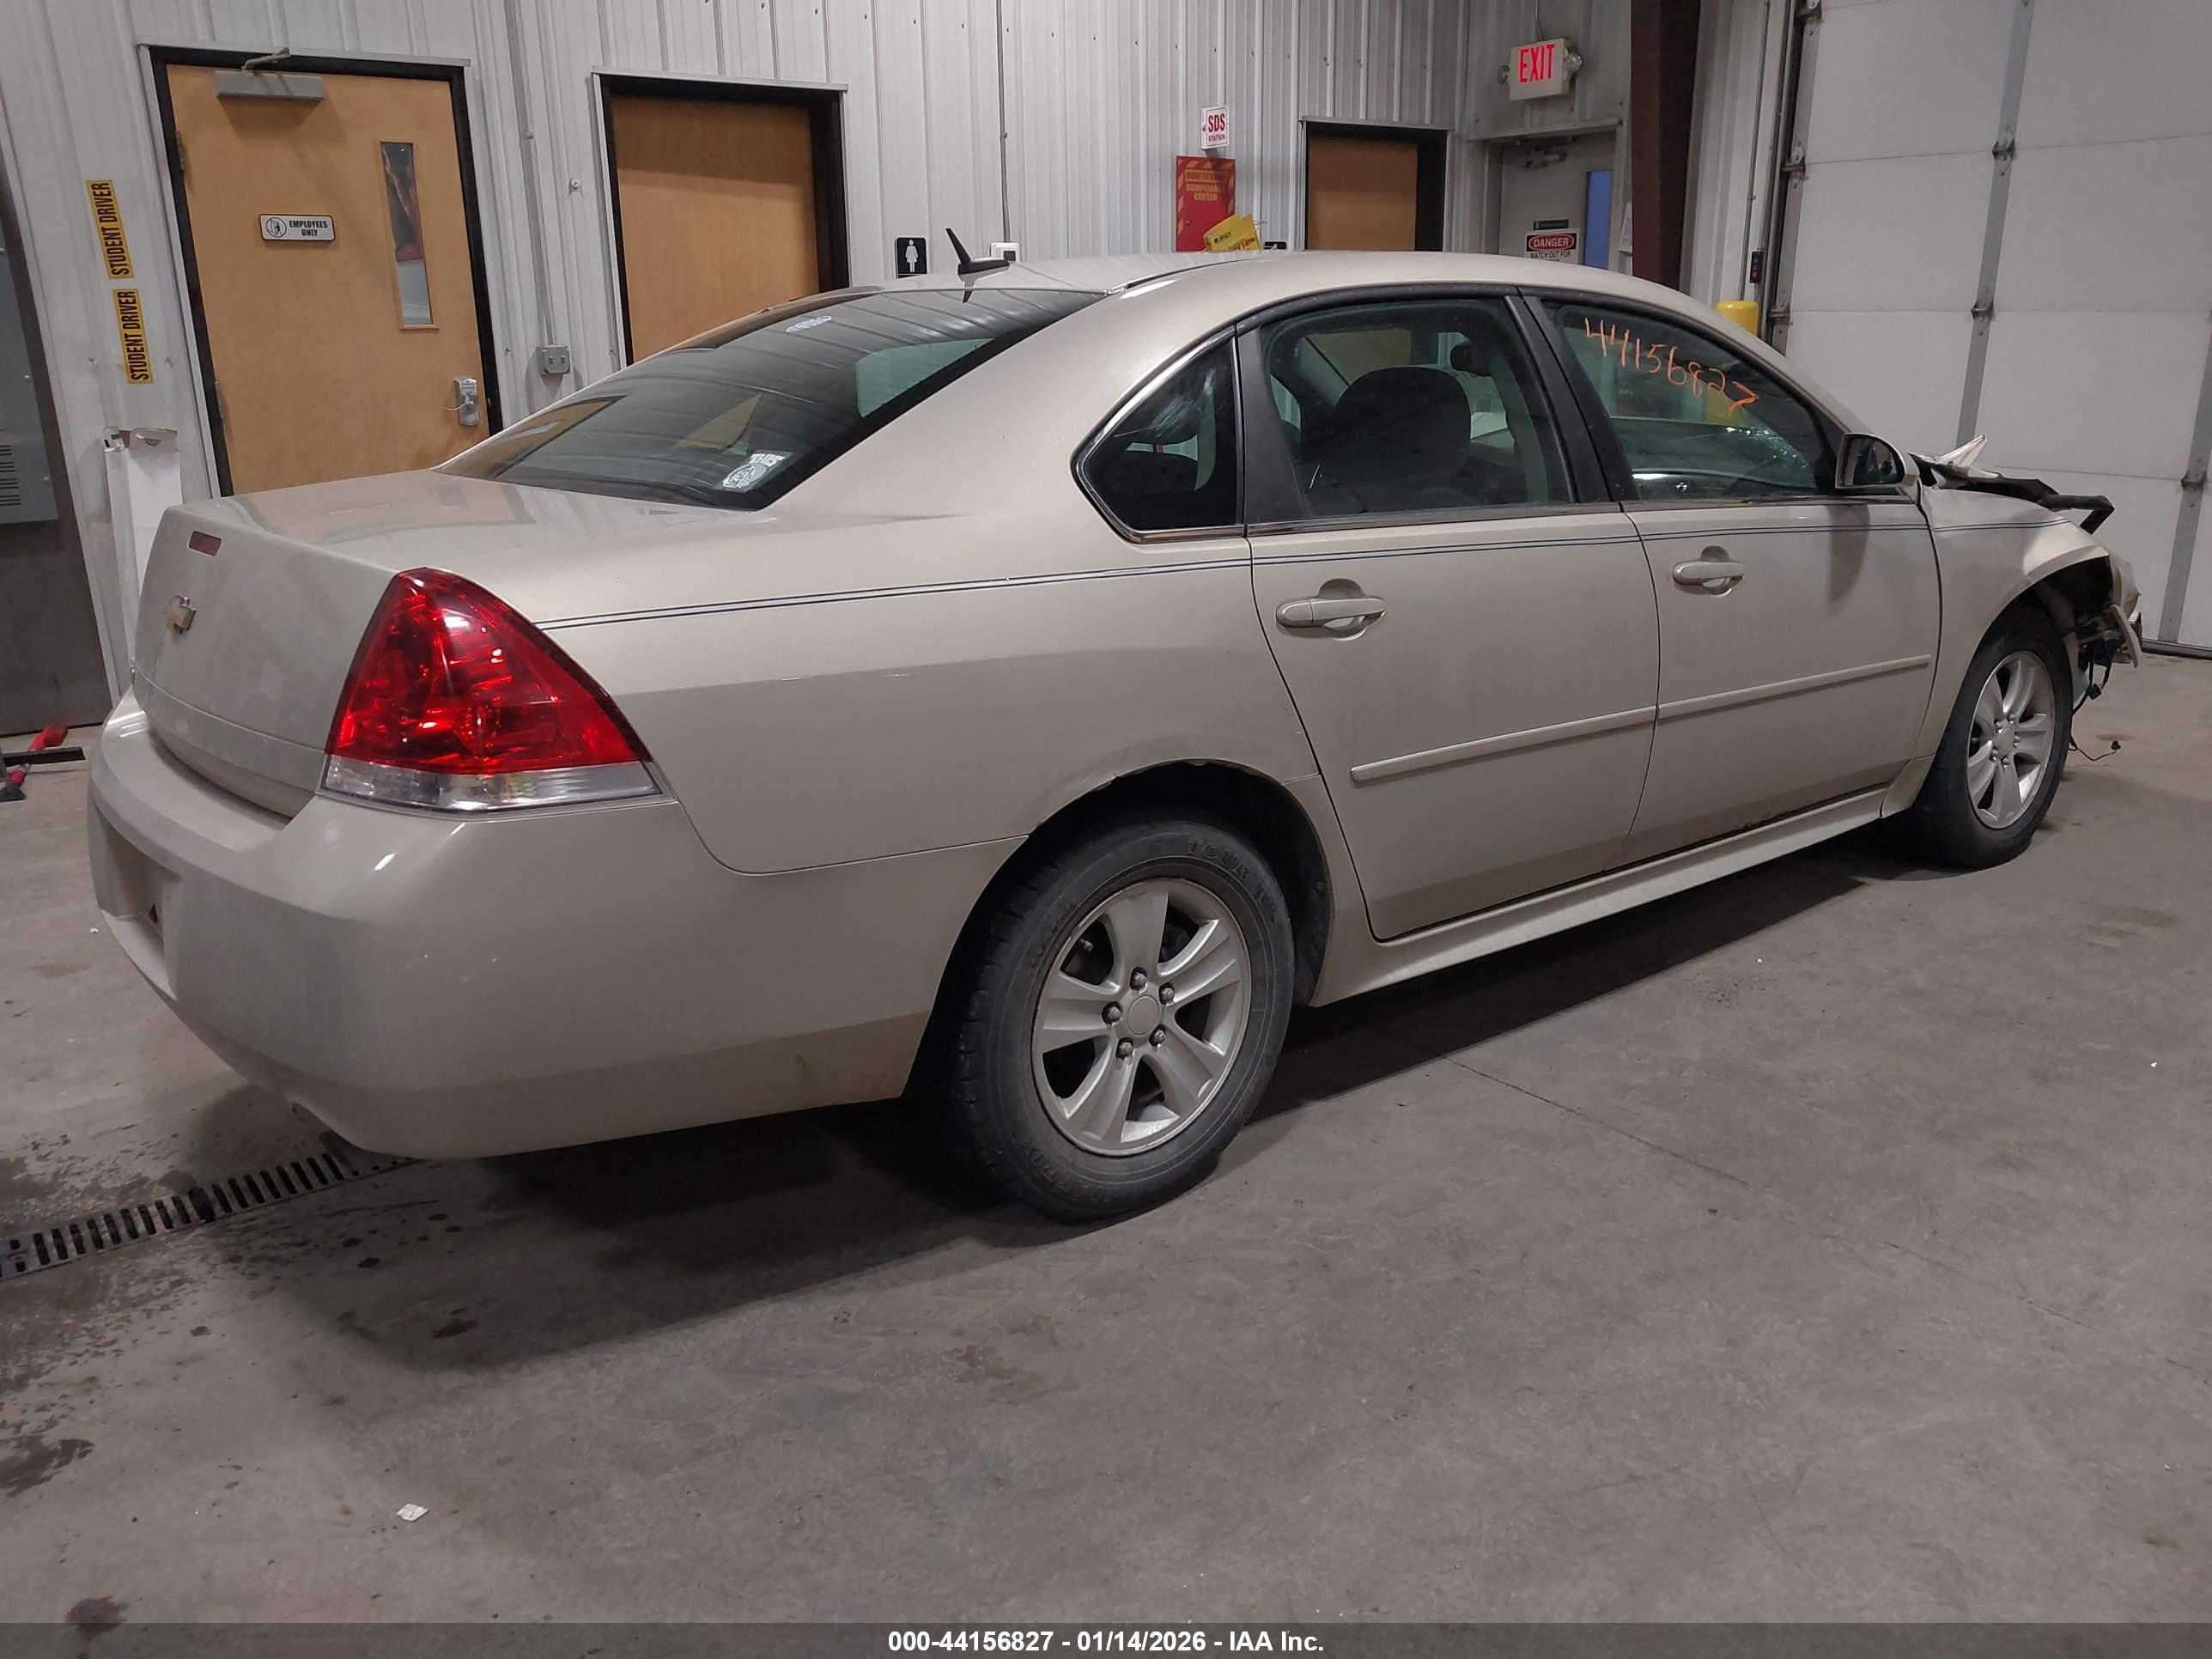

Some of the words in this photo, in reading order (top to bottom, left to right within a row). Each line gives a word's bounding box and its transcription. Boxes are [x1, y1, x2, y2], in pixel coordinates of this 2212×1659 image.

[1519, 44, 1555, 82] EXIT
[1208, 113, 1225, 132] SDS
[91, 182, 118, 223] DRIVER
[289, 220, 328, 228] EMPLOYEES
[1534, 237, 1569, 248] DANGER
[100, 226, 130, 276] STUDENT
[117, 291, 141, 330] DRIVER
[124, 332, 149, 380] STUDENT
[1584, 317, 1759, 418] 44156827
[1188, 838, 1250, 880] TOUR
